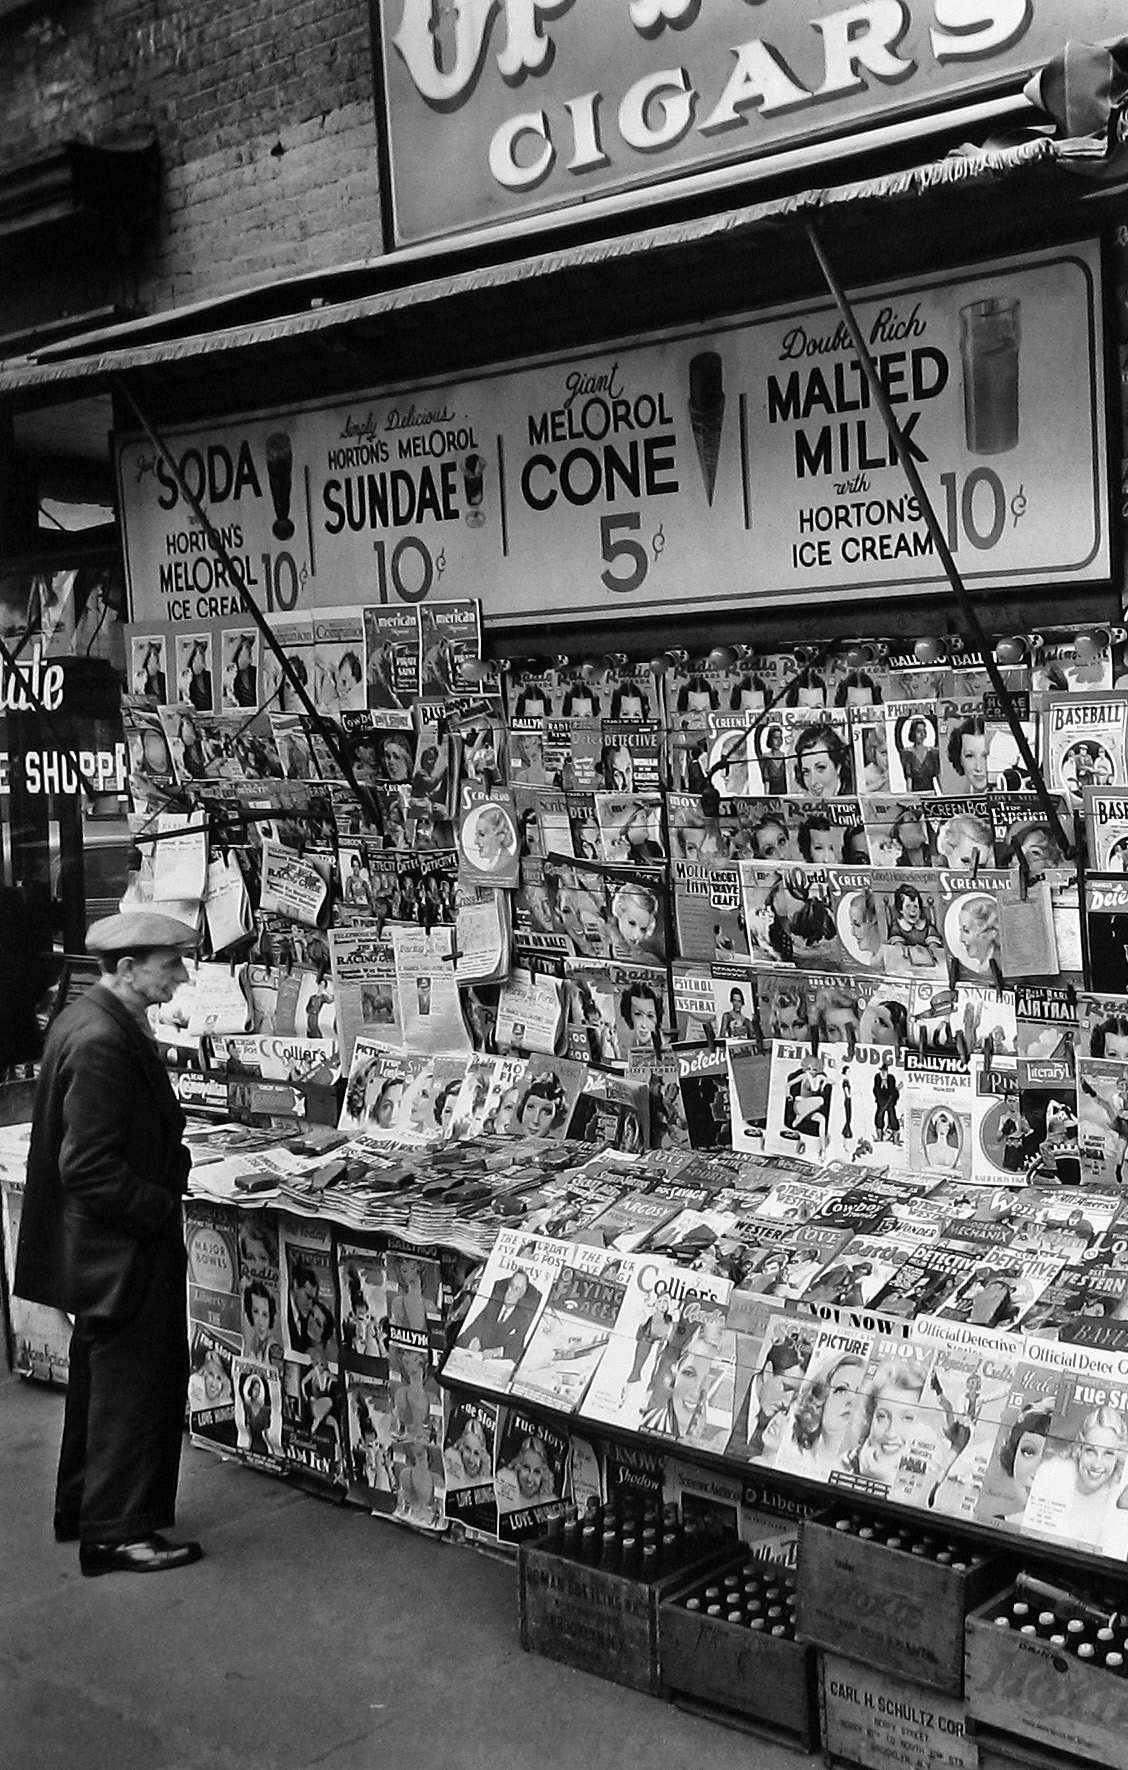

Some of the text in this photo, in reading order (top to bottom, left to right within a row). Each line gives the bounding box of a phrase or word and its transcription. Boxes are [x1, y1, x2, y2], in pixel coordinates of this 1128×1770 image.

[488, 0, 1033, 191] CIGARS
[869, 303, 927, 346] Rich
[564, 361, 623, 407] Giant
[767, 346, 949, 425] MALTED
[527, 390, 674, 447] MELOROL
[327, 427, 478, 472] HORTON'S MELOROL
[794, 412, 930, 479] MILK
[156, 439, 262, 511] SODA
[520, 435, 679, 511] CONE
[833, 474, 871, 496] with
[323, 462, 460, 536] SUNDAE
[799, 494, 923, 533] HORTON'S
[165, 525, 244, 555] HORTON'S
[792, 530, 934, 568] ICE CREAM
[159, 553, 258, 594] MELOROL
[167, 600, 191, 621] ICE
[1055, 704, 1122, 730] BASEBALL
[604, 734, 658, 748] DETECTIVE
[939, 871, 1012, 900] SCREENLAND
[272, 1041, 326, 1064] Collier's
[619, 1199, 671, 1217] ARGOSY
[667, 1187, 707, 1200] SAVAGE
[501, 1232, 521, 1248] THE
[896, 1219, 937, 1238] WONDER
[192, 1241, 226, 1258] MAJOR
[580, 1250, 601, 1264] THE
[637, 1264, 718, 1304] Collier's
[1056, 1270, 1127, 1294] WESTERN
[580, 1301, 619, 1321] ACES
[849, 1312, 894, 1335] NOW
[818, 1331, 870, 1357] PICTURE
[916, 1320, 1017, 1354] Official Detective
[1029, 1346, 1076, 1369] Official
[508, 1512, 535, 1531] LOVE
[830, 1681, 860, 1704] CARL
[878, 1696, 934, 1729] SCHULTZ
